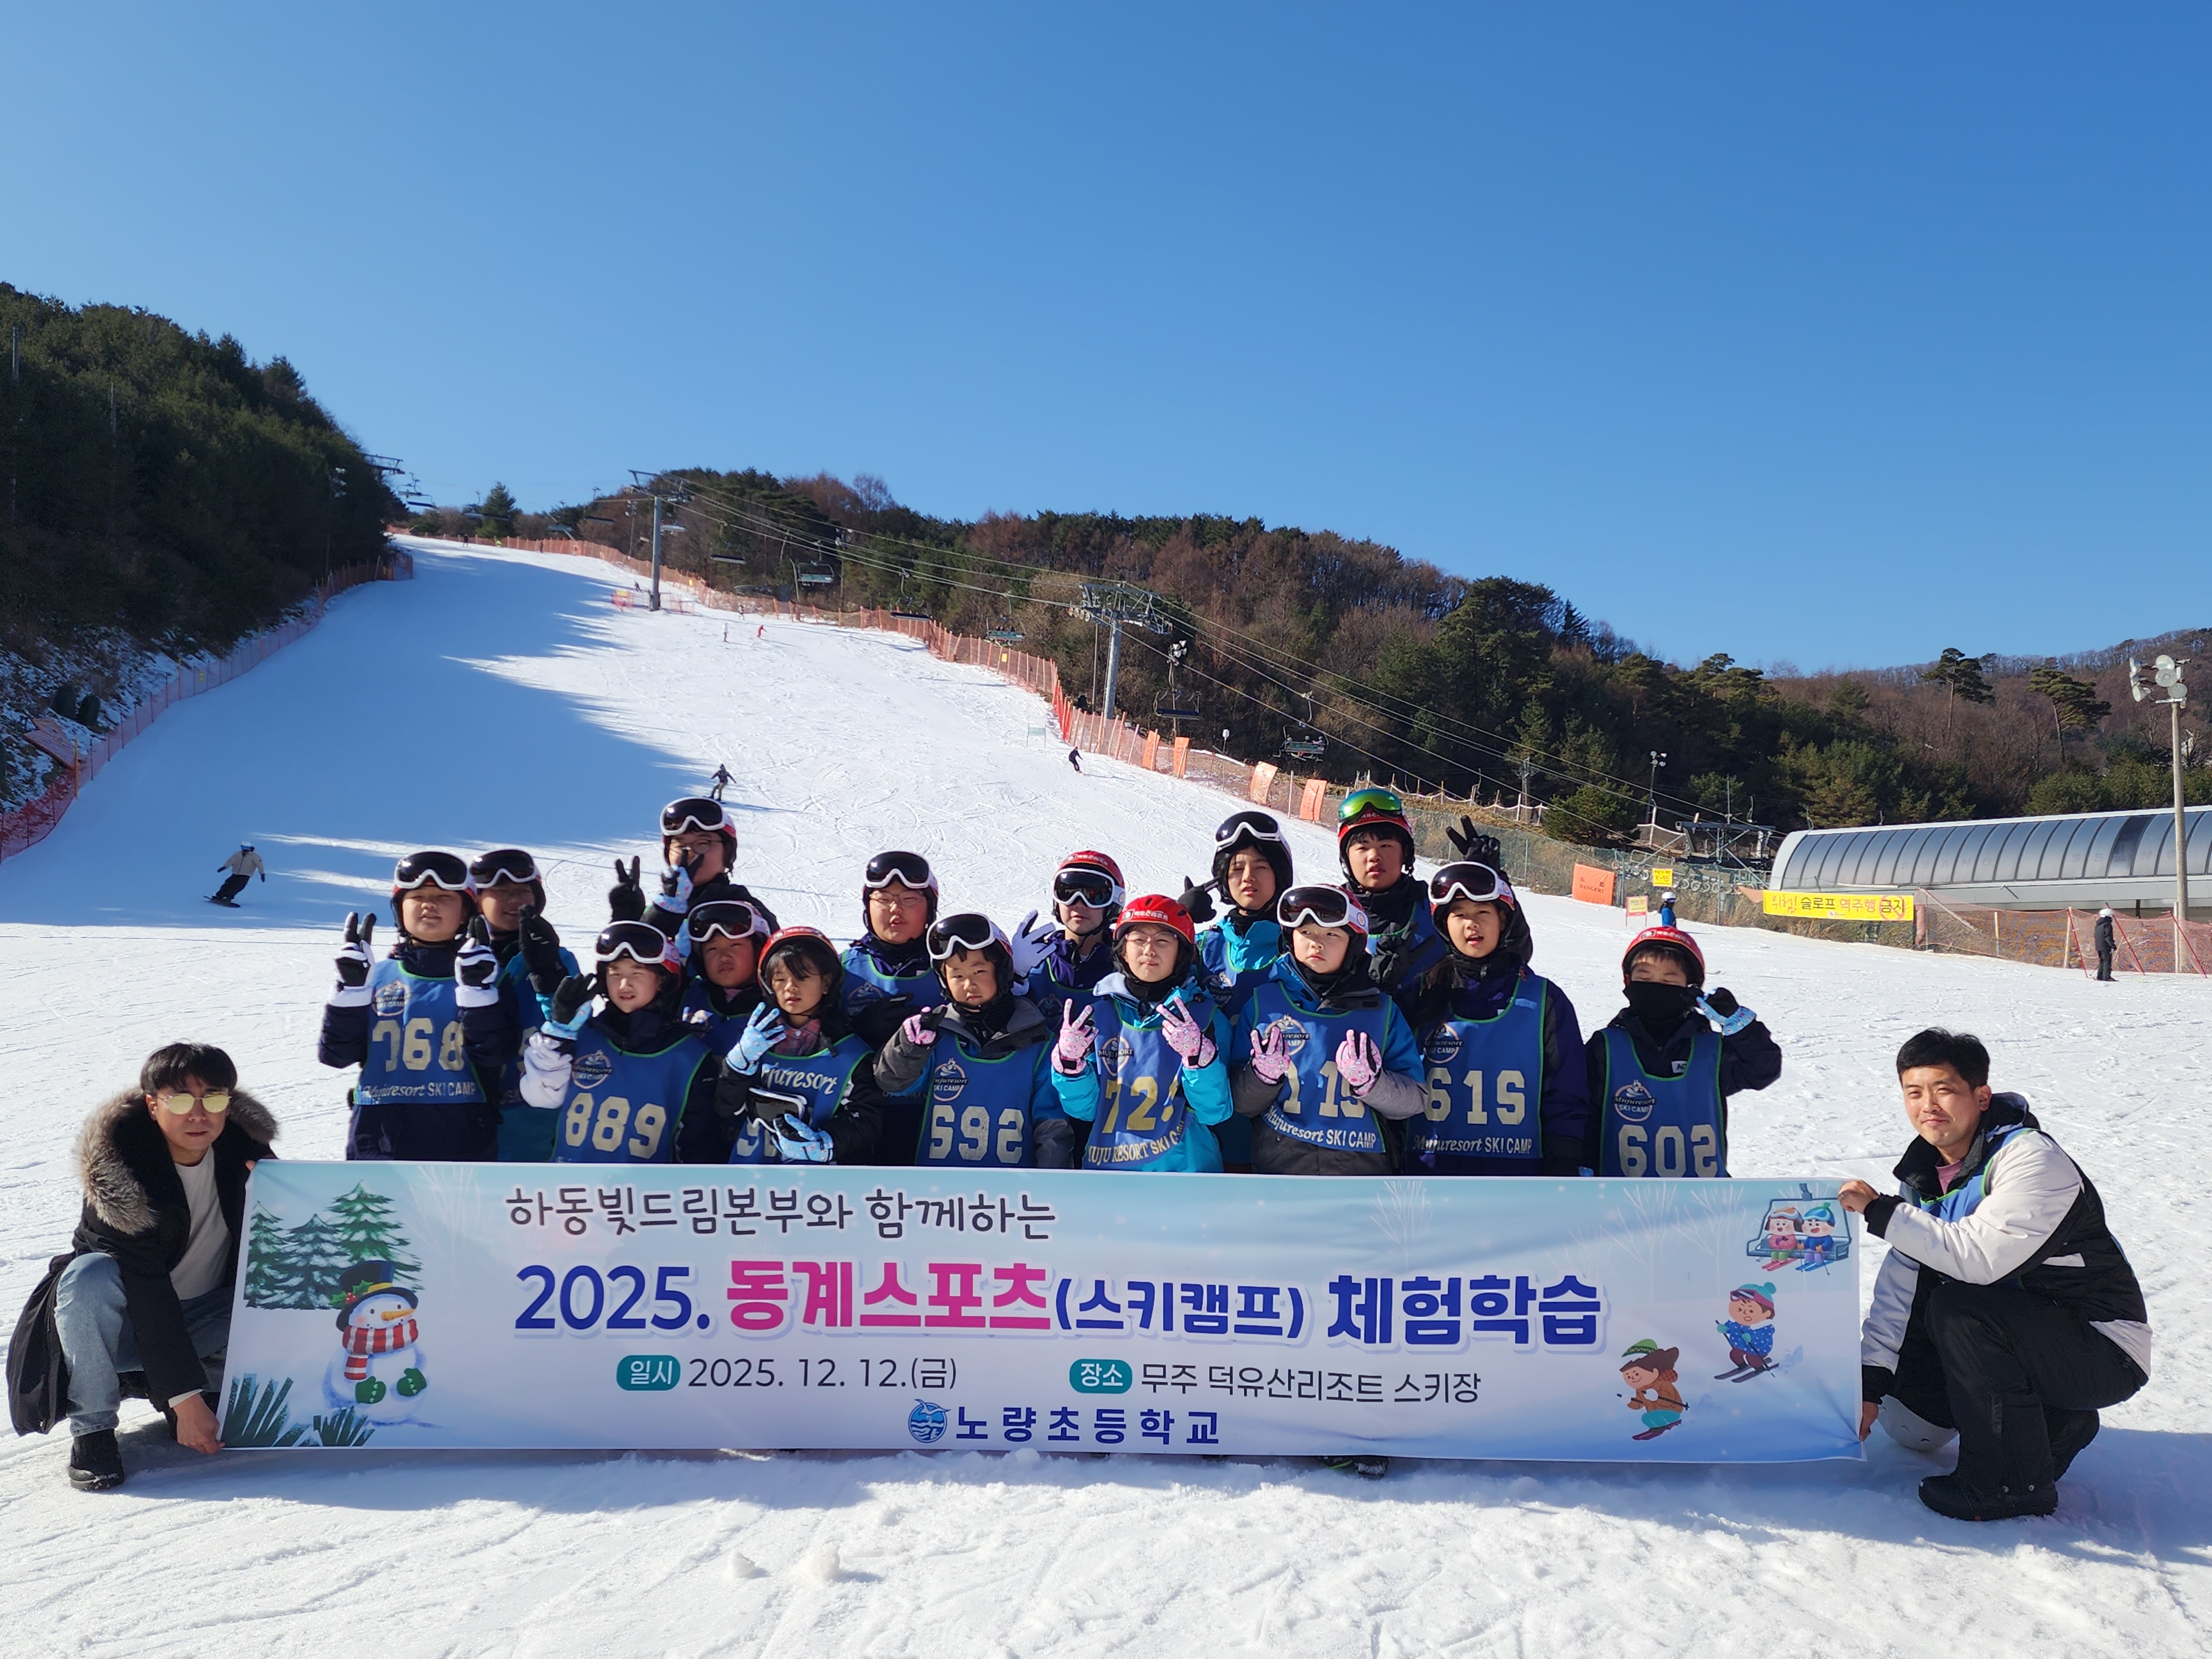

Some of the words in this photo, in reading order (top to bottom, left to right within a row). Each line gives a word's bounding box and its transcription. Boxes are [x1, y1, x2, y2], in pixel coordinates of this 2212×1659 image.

[1800, 896, 1836, 910] 슬로프
[1840, 898, 1876, 912] 역주행
[1880, 899, 1905, 913] 금지
[1423, 1067, 1525, 1125] 615
[565, 1092, 666, 1160] 889
[928, 1104, 1025, 1164] 592
[1326, 1129, 1347, 1146] SKI
[1348, 1130, 1376, 1149] CAMP
[1484, 1136, 1504, 1154] SKI
[1506, 1137, 1532, 1154] CAMP
[1112, 1142, 1149, 1163] RESORT
[1150, 1135, 1171, 1155] SKI
[1618, 1124, 1718, 1178] 602
[506, 1187, 853, 1236] 하동빛드림본부와
[865, 1188, 1056, 1240] 함께하는
[514, 1265, 711, 1331] 2025.
[726, 1260, 1305, 1339] 동계스포츠(스키캠프)
[1327, 1274, 1601, 1347] 체험학습
[628, 1359, 675, 1386] 일시
[688, 1358, 785, 1387] 2025.
[798, 1358, 846, 1388] 12.
[860, 1356, 957, 1391] 12.(금)
[1079, 1363, 1124, 1387] 장소
[1141, 1364, 1197, 1394] 무주
[1208, 1365, 1384, 1404] 덕유산리조트
[1394, 1370, 1481, 1404] 스키장
[956, 1406, 1220, 1446] 노량초등학교
